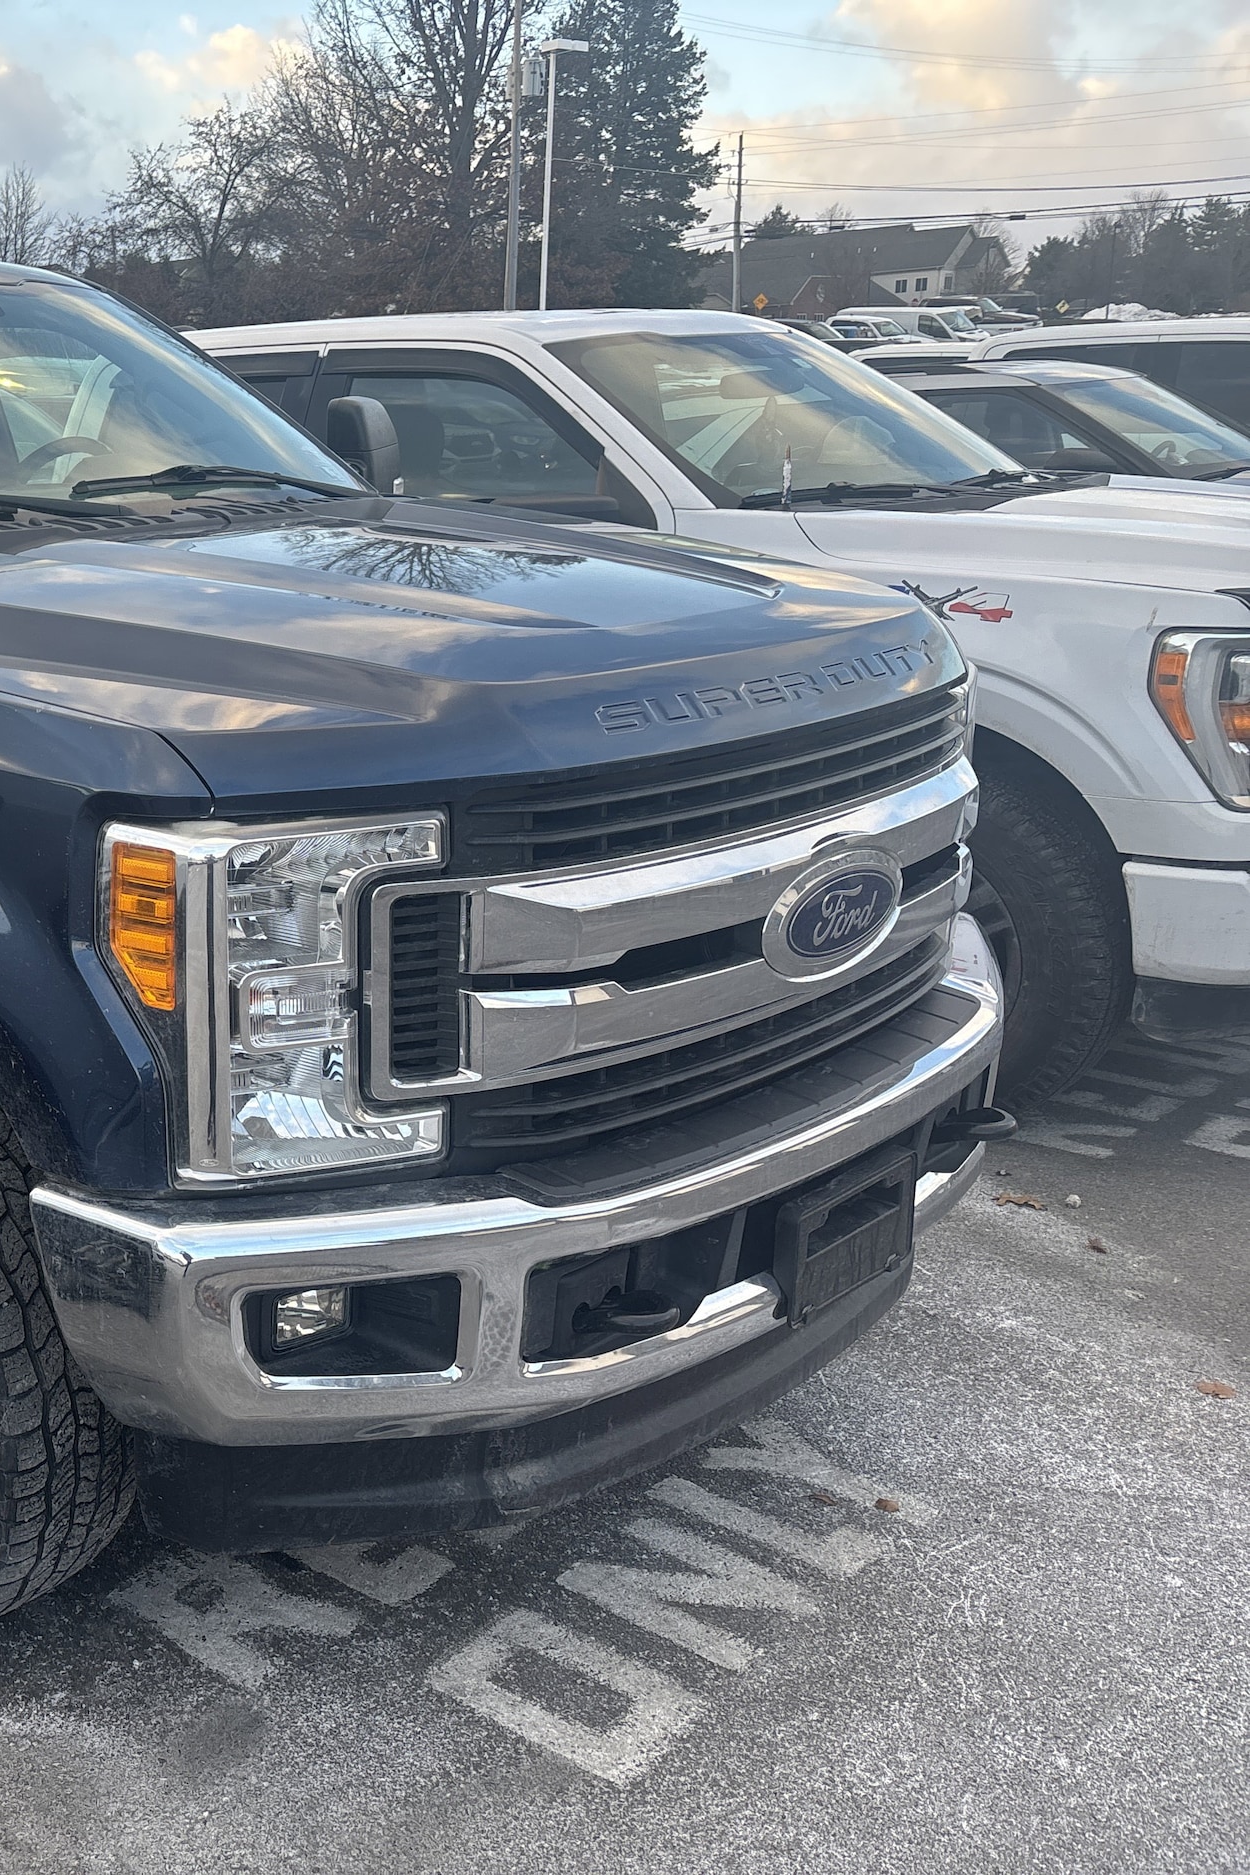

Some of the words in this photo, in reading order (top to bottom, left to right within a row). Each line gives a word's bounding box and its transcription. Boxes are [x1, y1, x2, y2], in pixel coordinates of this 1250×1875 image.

[594, 669, 823, 736] SUPER
[820, 638, 936, 693] DUTY
[812, 883, 877, 948] Ford
[427, 1416, 938, 1787] ONLY
